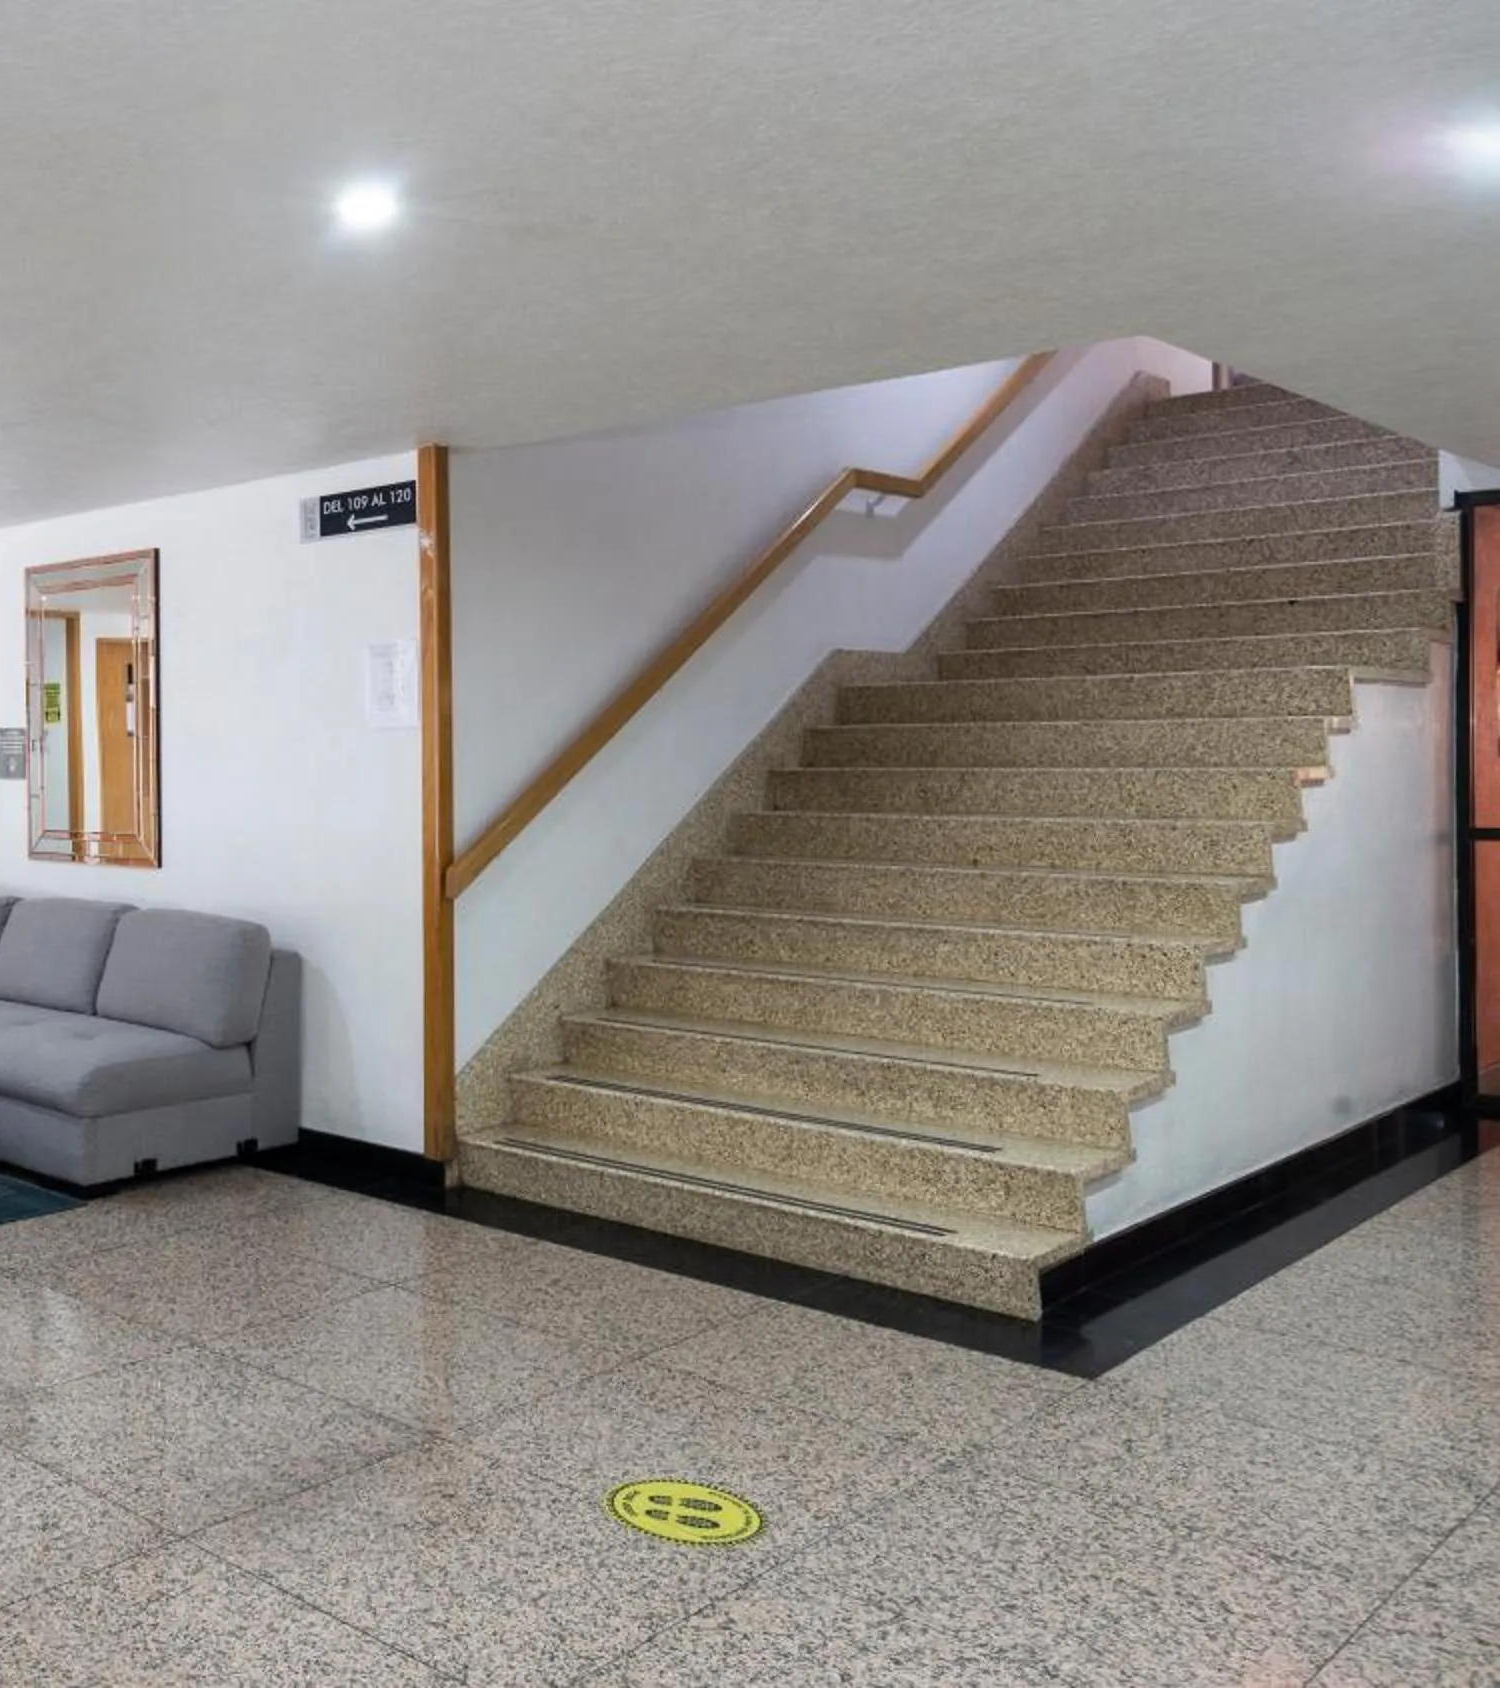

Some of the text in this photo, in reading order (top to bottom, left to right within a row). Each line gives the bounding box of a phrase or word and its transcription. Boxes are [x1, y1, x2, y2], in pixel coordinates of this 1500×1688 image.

[323, 488, 412, 514] DEL 109 AL 120
